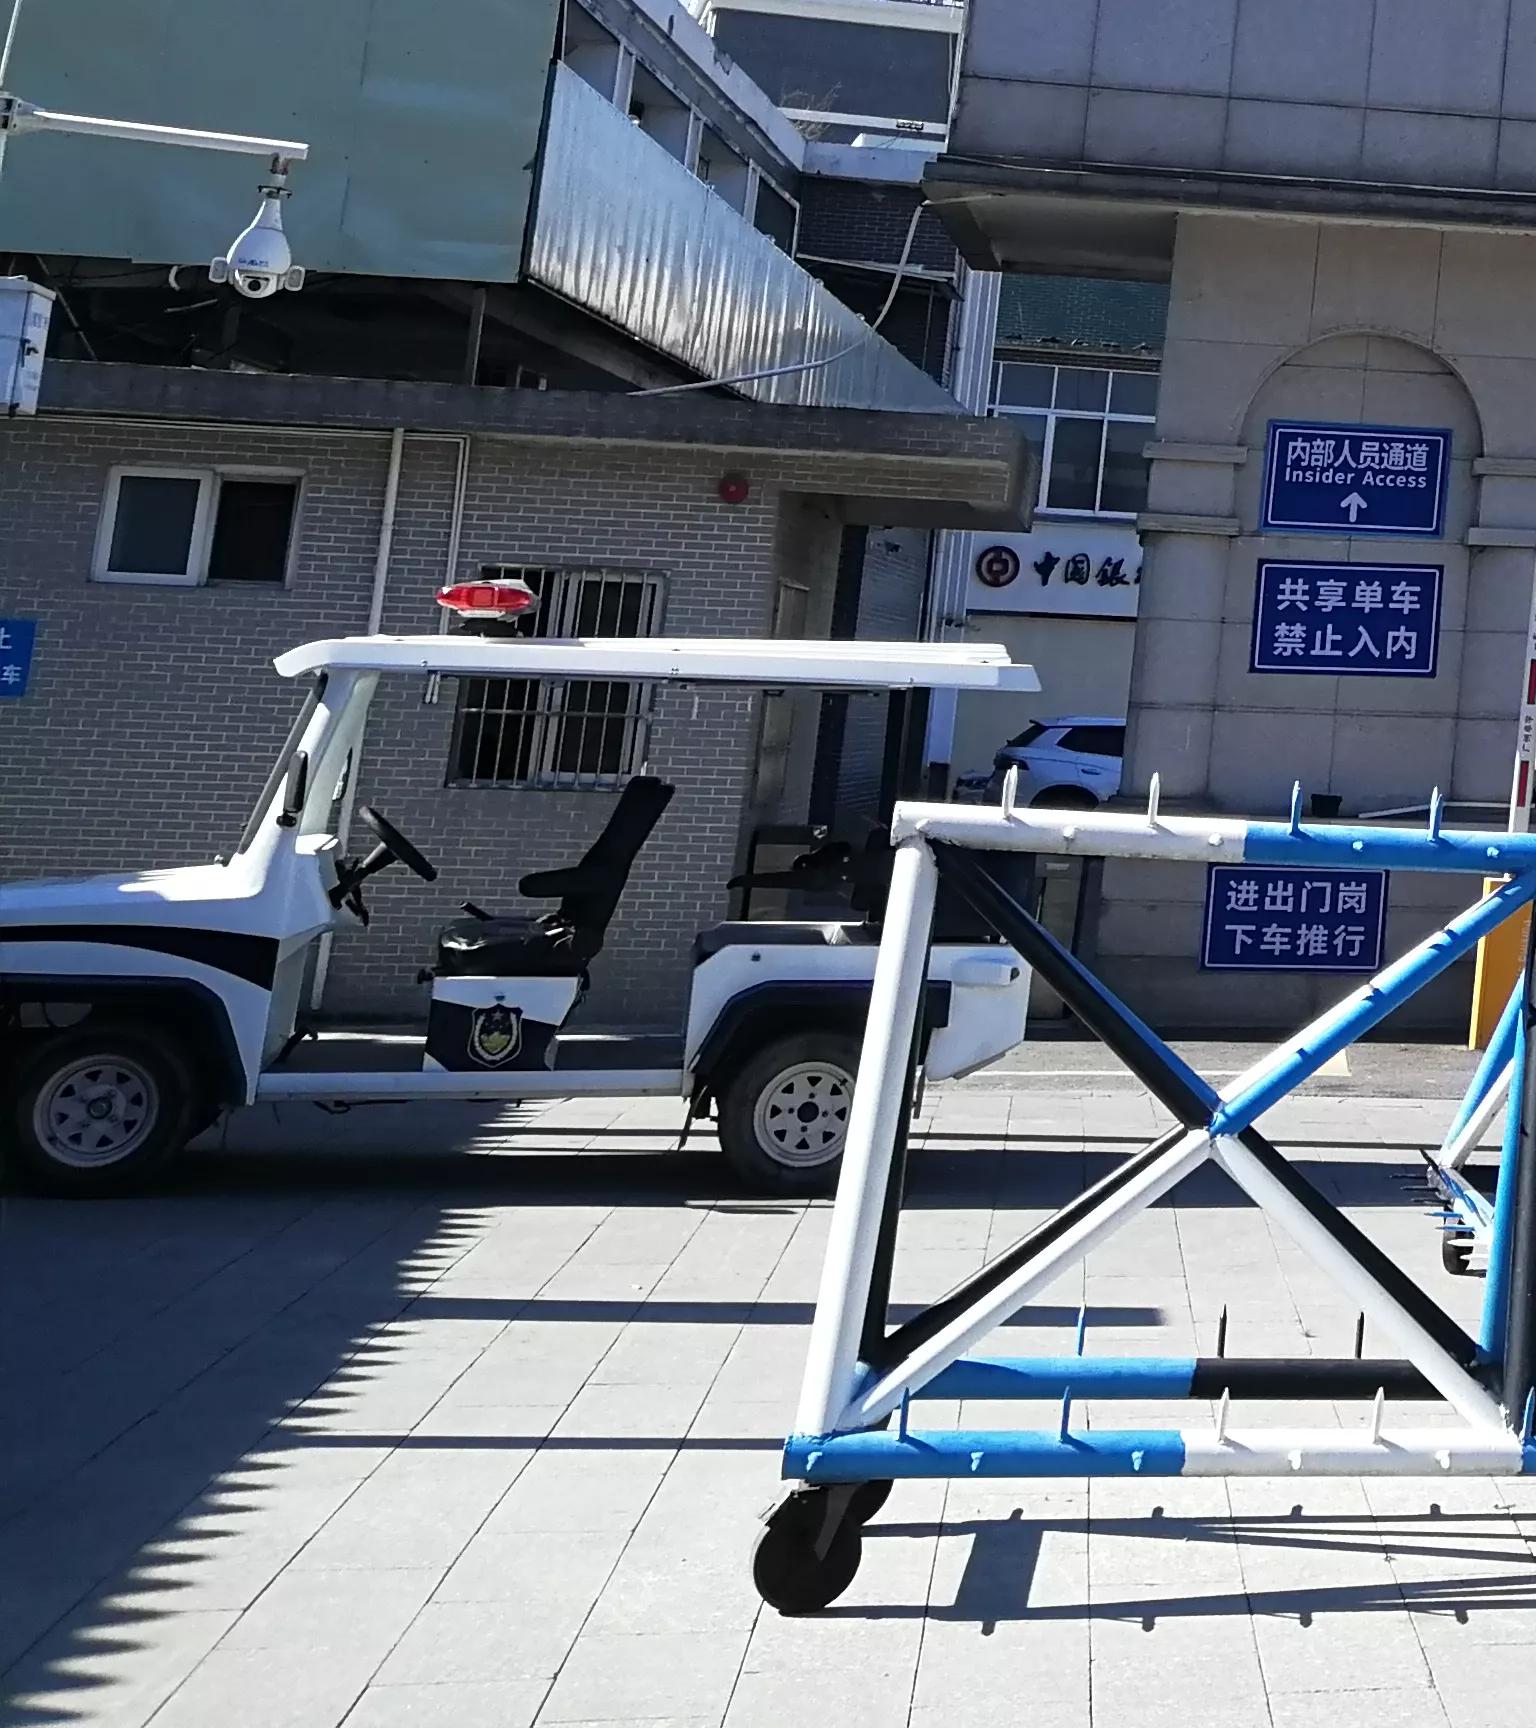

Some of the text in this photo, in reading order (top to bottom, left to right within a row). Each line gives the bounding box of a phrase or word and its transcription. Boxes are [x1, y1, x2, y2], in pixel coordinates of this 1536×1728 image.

[1286, 437, 1430, 472] 内部人员通道
[1285, 467, 1428, 489] Insider Access
[1033, 551, 1143, 587] 中国银
[1276, 577, 1421, 615] 共享单车
[1272, 622, 1418, 660] 禁止入内
[1225, 879, 1368, 914] 进出门岗
[1225, 922, 1366, 957] 下车推行
